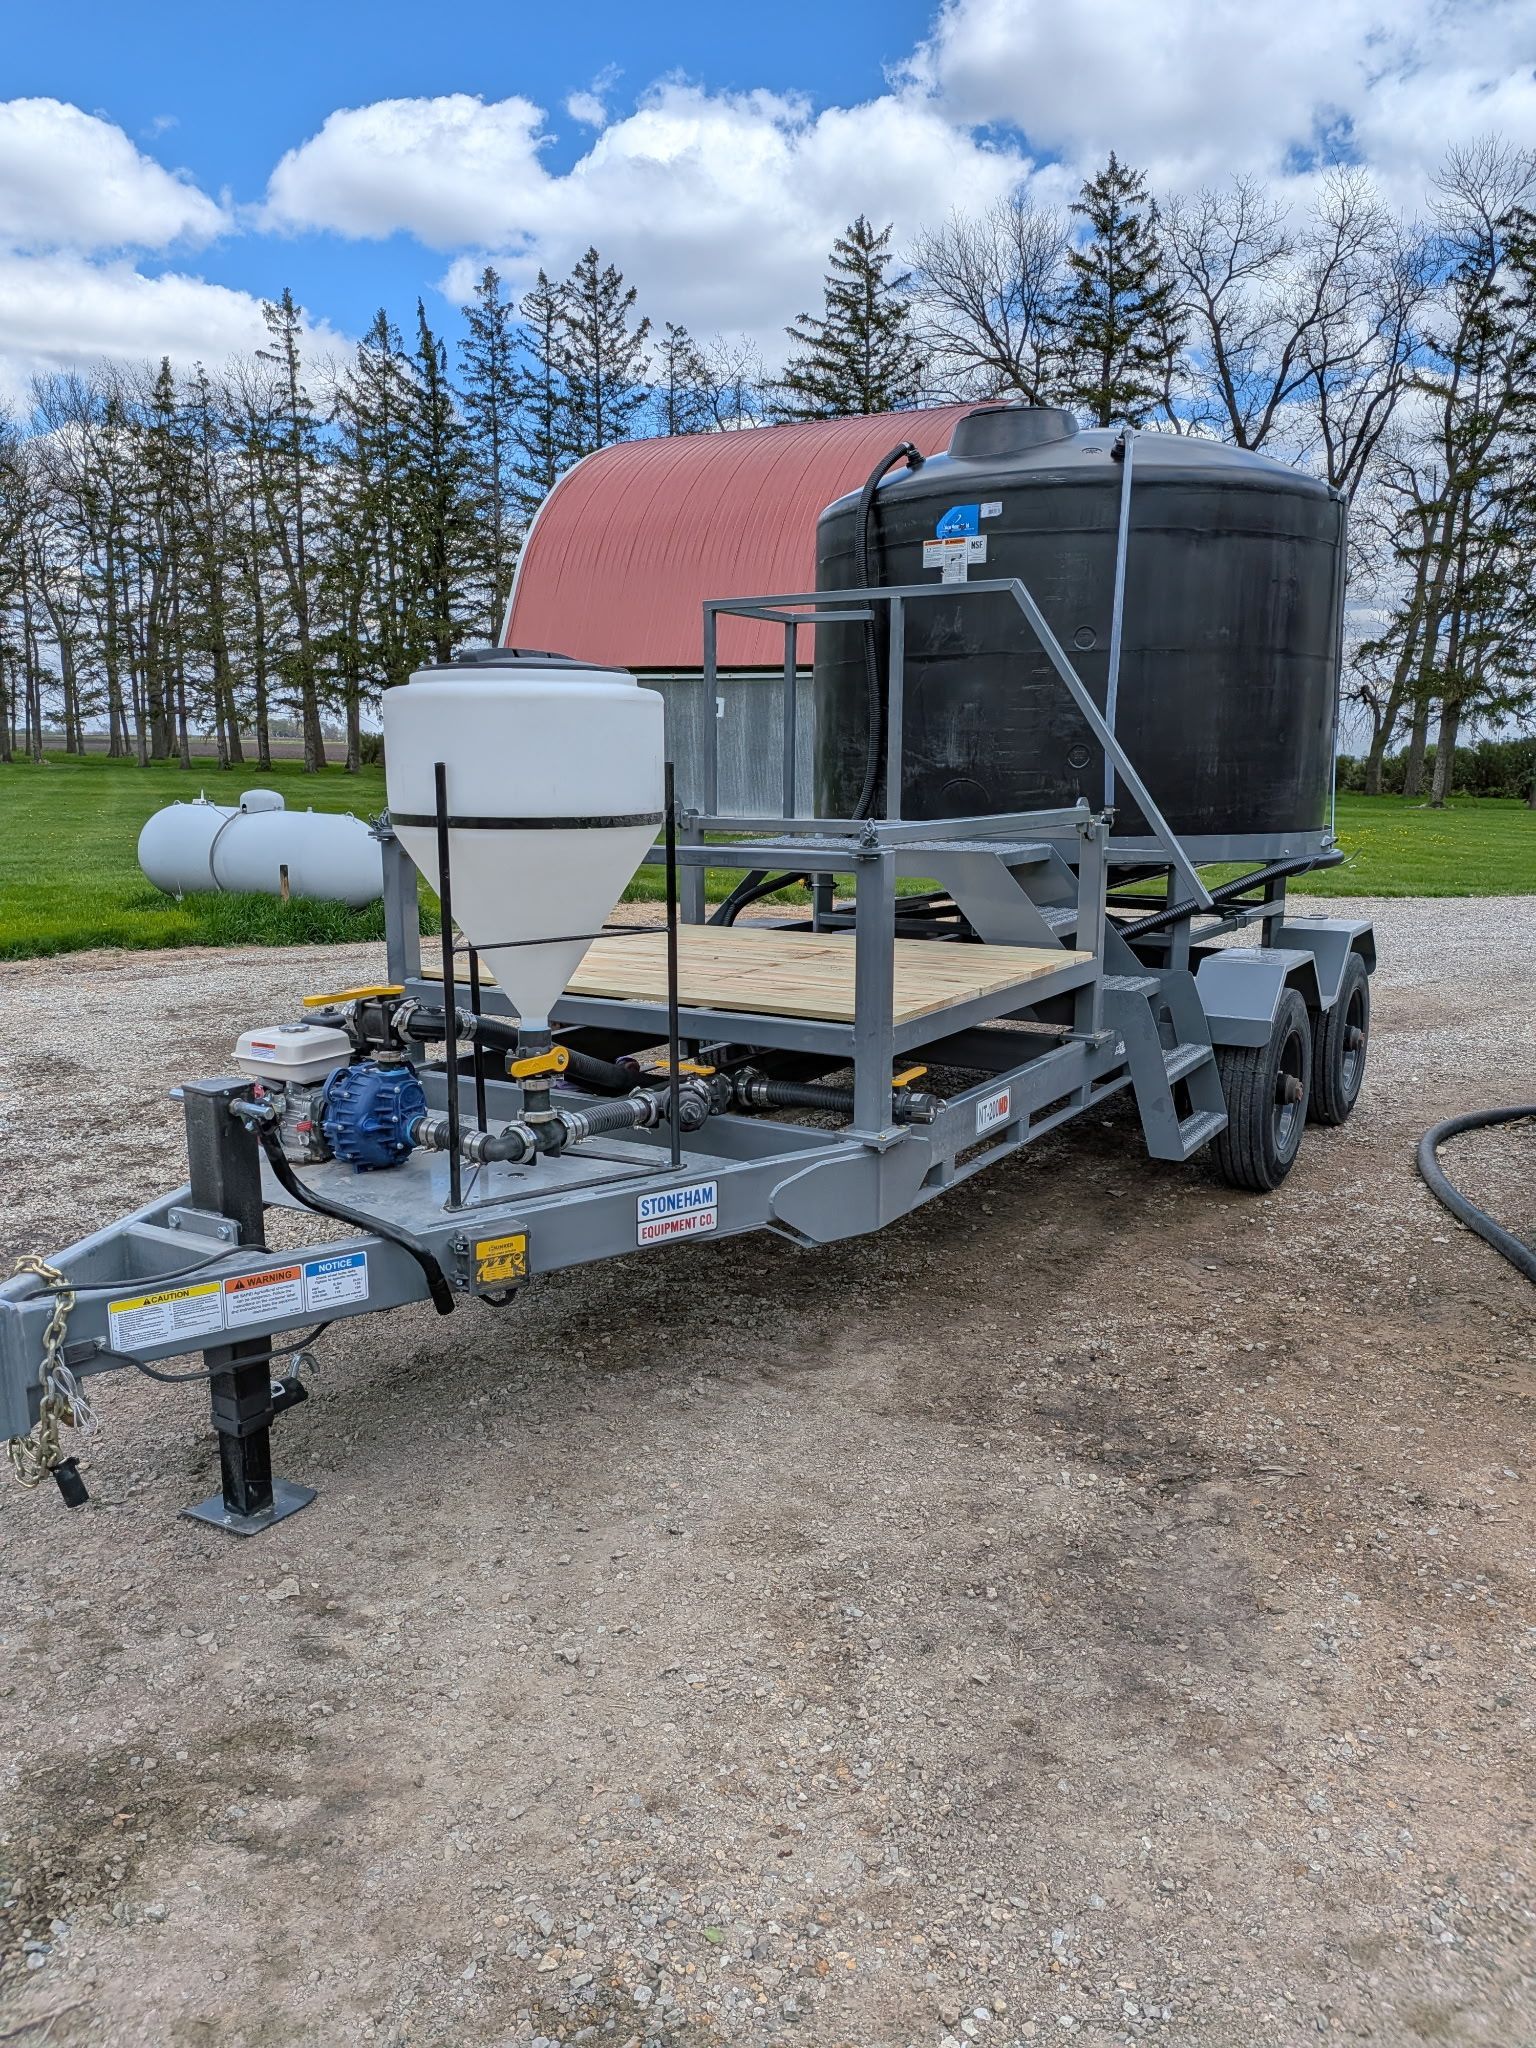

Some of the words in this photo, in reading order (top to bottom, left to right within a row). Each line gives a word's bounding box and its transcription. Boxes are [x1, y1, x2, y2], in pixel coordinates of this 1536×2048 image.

[641, 1186, 713, 1217] STONEHAM
[641, 1216, 698, 1240] EQUIPMENT
[699, 1213, 715, 1227] CO.
[318, 1258, 353, 1273] NOTICE
[247, 1270, 292, 1287] WARNING
[151, 1290, 190, 1303] CAUTION
